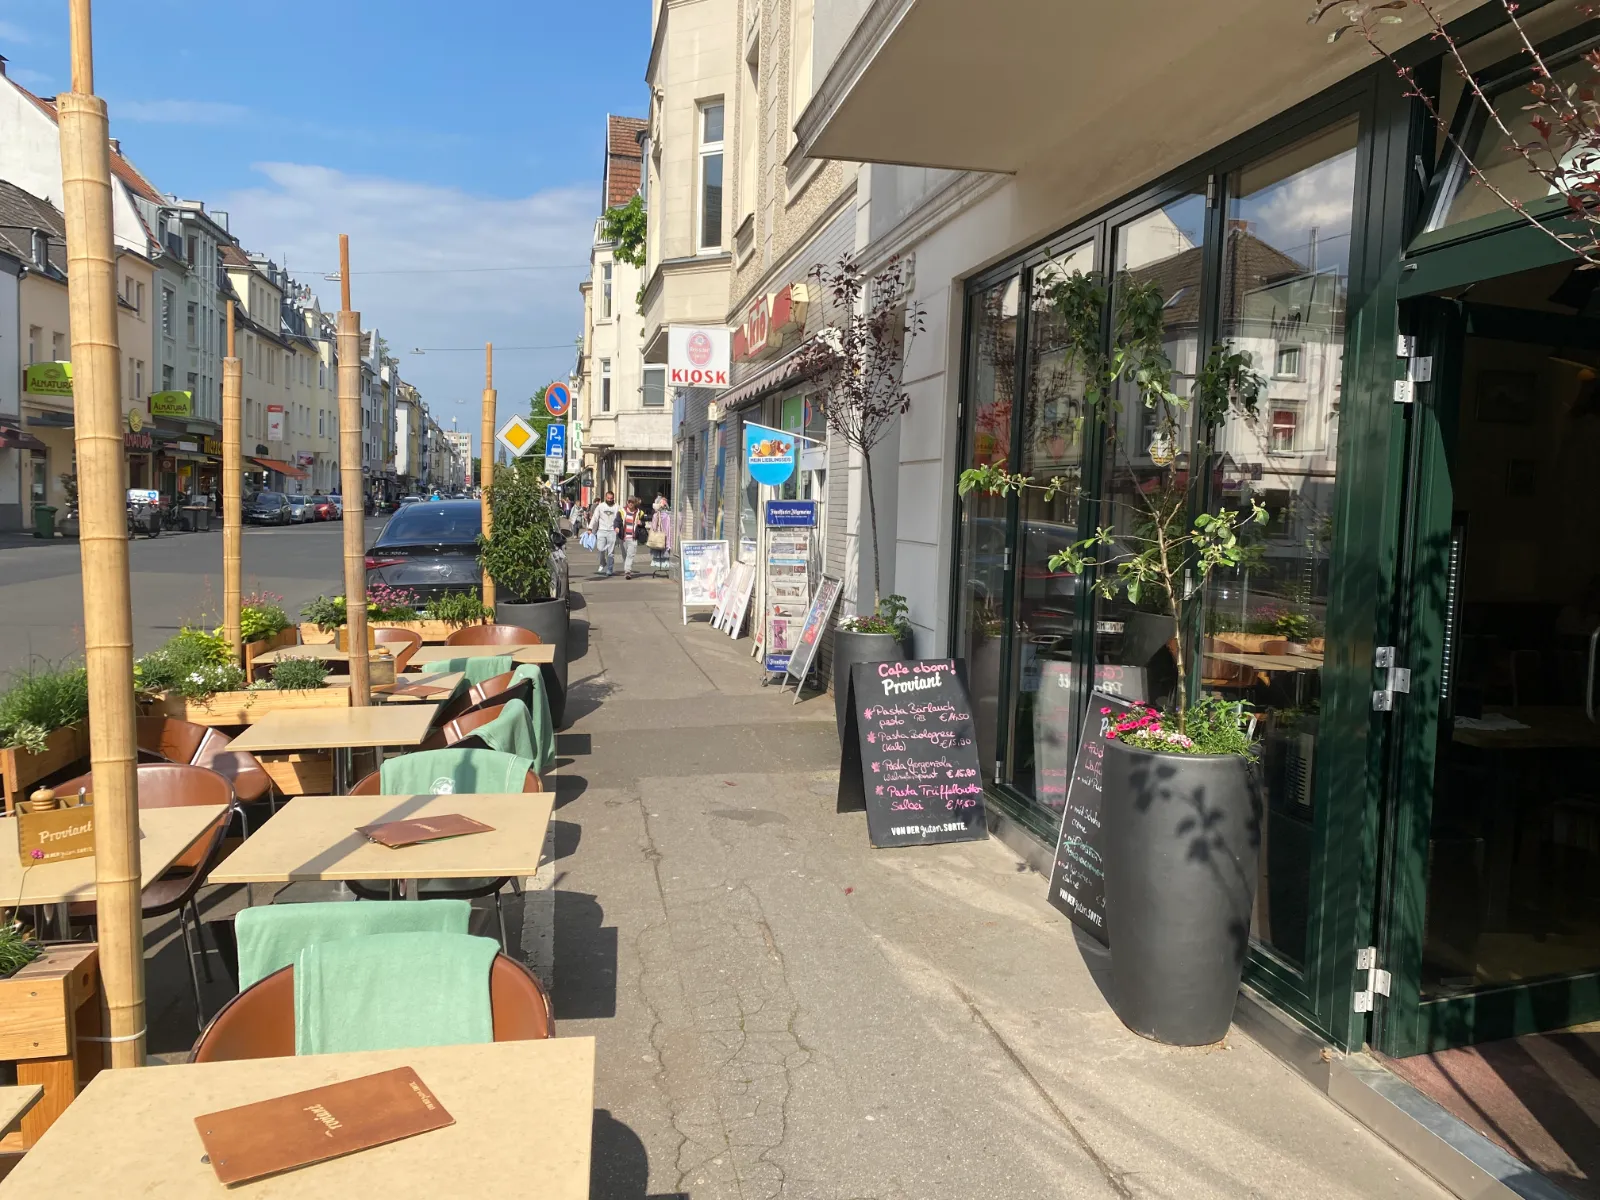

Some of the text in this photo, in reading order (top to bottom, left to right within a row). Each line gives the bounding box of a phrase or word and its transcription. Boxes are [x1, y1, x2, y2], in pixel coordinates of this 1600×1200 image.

[31, 378, 73, 389] ALNATURA
[671, 368, 727, 384] KIOSK
[153, 402, 187, 412] ALNATURA
[549, 426, 558, 440] P
[574, 423, 582, 449] BIO
[878, 662, 909, 678] Cafe
[881, 672, 943, 696] Proviant
[873, 701, 956, 716] Pasta Bärlauch
[879, 715, 905, 729] pesto
[878, 728, 956, 744] Pasta Bolognese
[882, 756, 953, 773] Pasta Gorgonzola
[887, 784, 917, 797] Pasta
[891, 799, 924, 811] Salbei
[38, 820, 93, 844] Proviant
[891, 826, 906, 836] VON
[906, 825, 920, 835] DER
[920, 824, 943, 838] guten
[302, 1103, 343, 1138] Proviant
